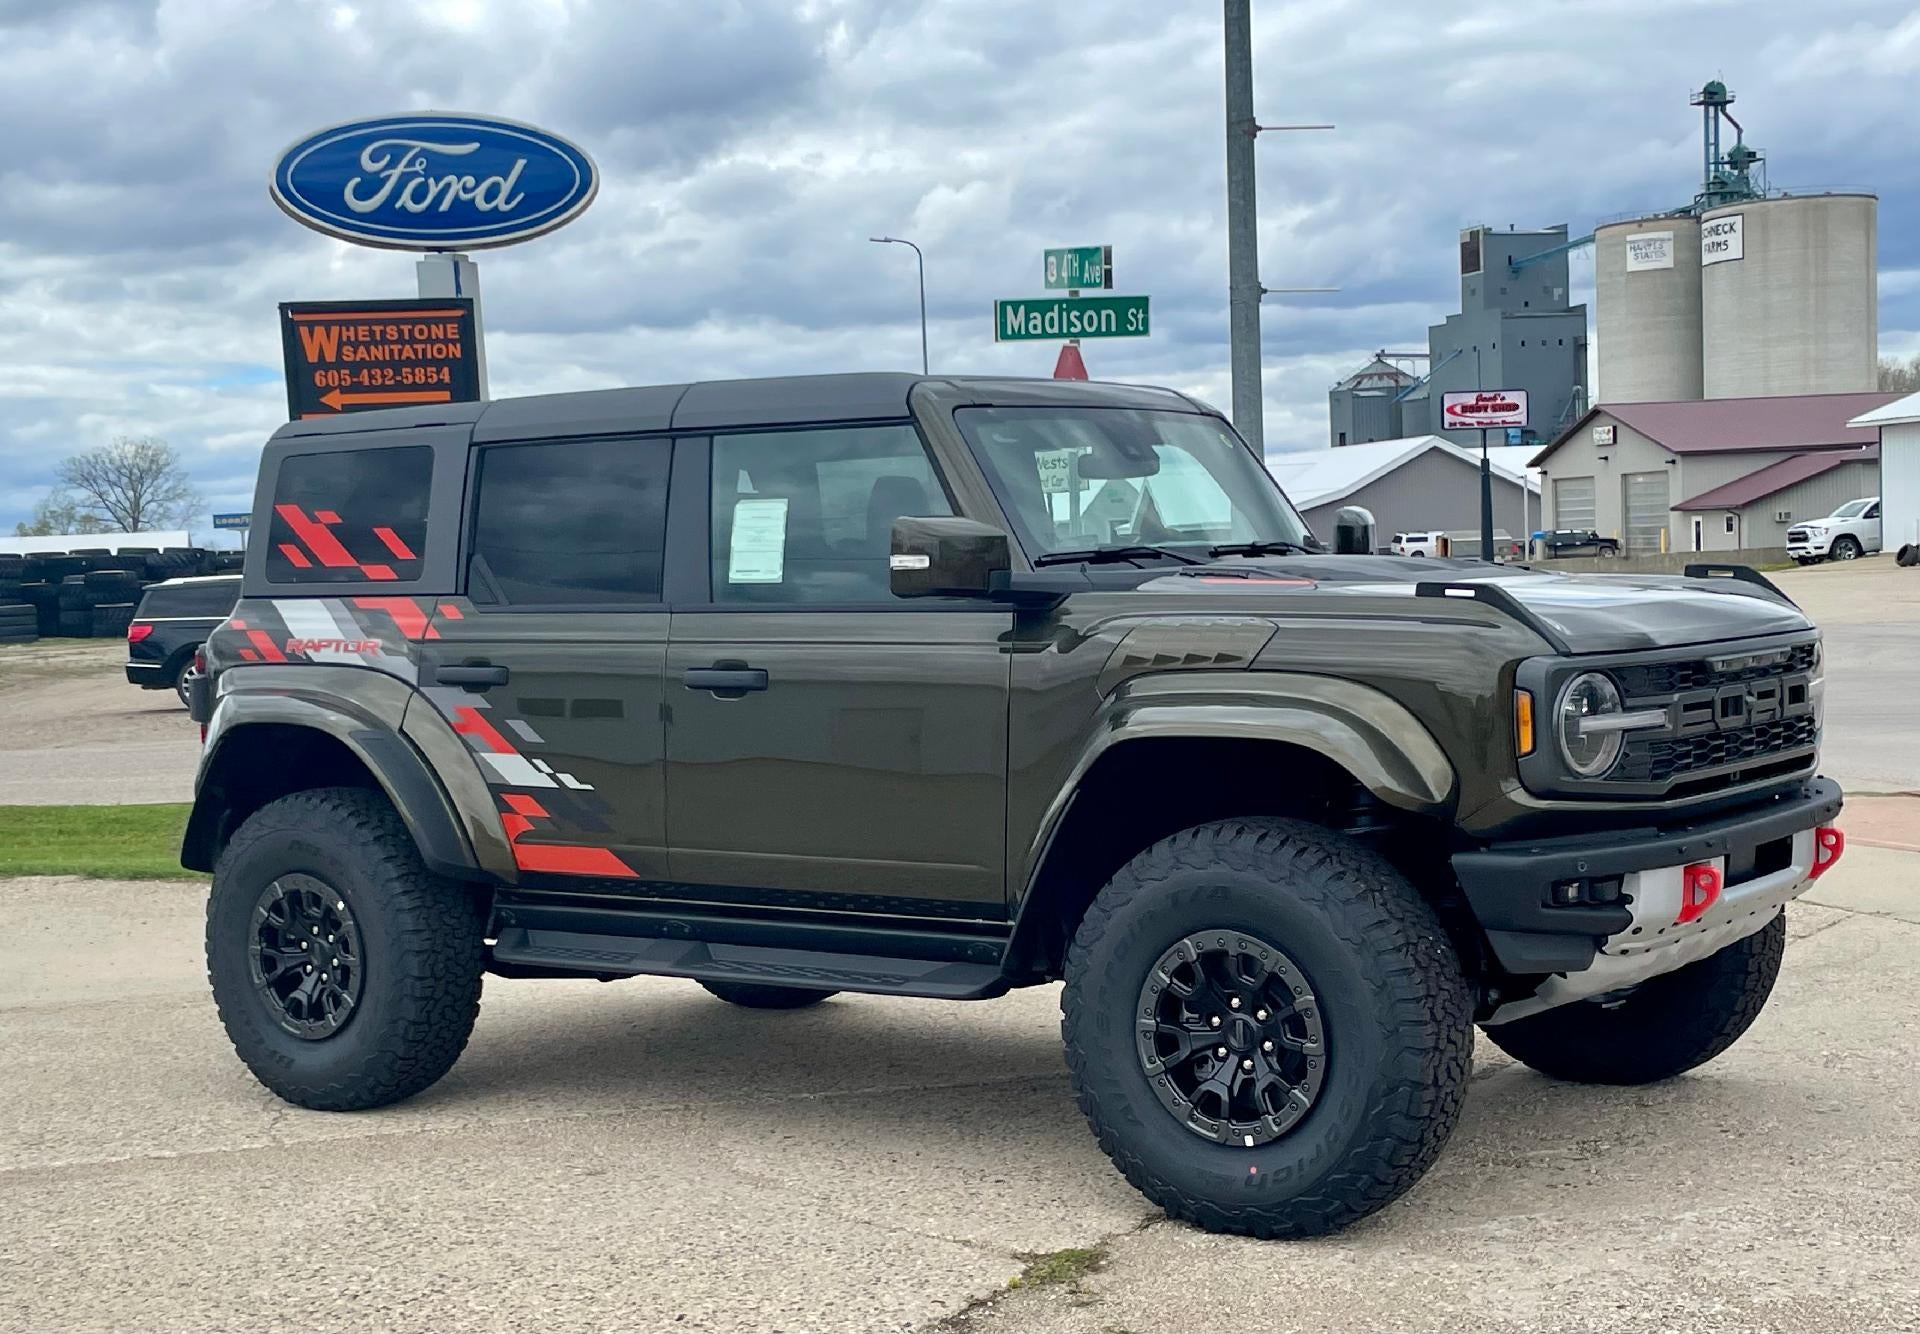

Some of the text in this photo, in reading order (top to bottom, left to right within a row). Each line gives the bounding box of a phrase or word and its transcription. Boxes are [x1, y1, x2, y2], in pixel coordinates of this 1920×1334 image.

[344, 139, 527, 213] Ford
[1083, 260, 1101, 284] Ave
[1006, 304, 1145, 335] Madison St
[300, 324, 459, 363] WHETSTONE
[342, 343, 462, 361] SANITATION
[314, 367, 450, 387] 605-432-5854
[287, 638, 382, 657] RAPTOR
